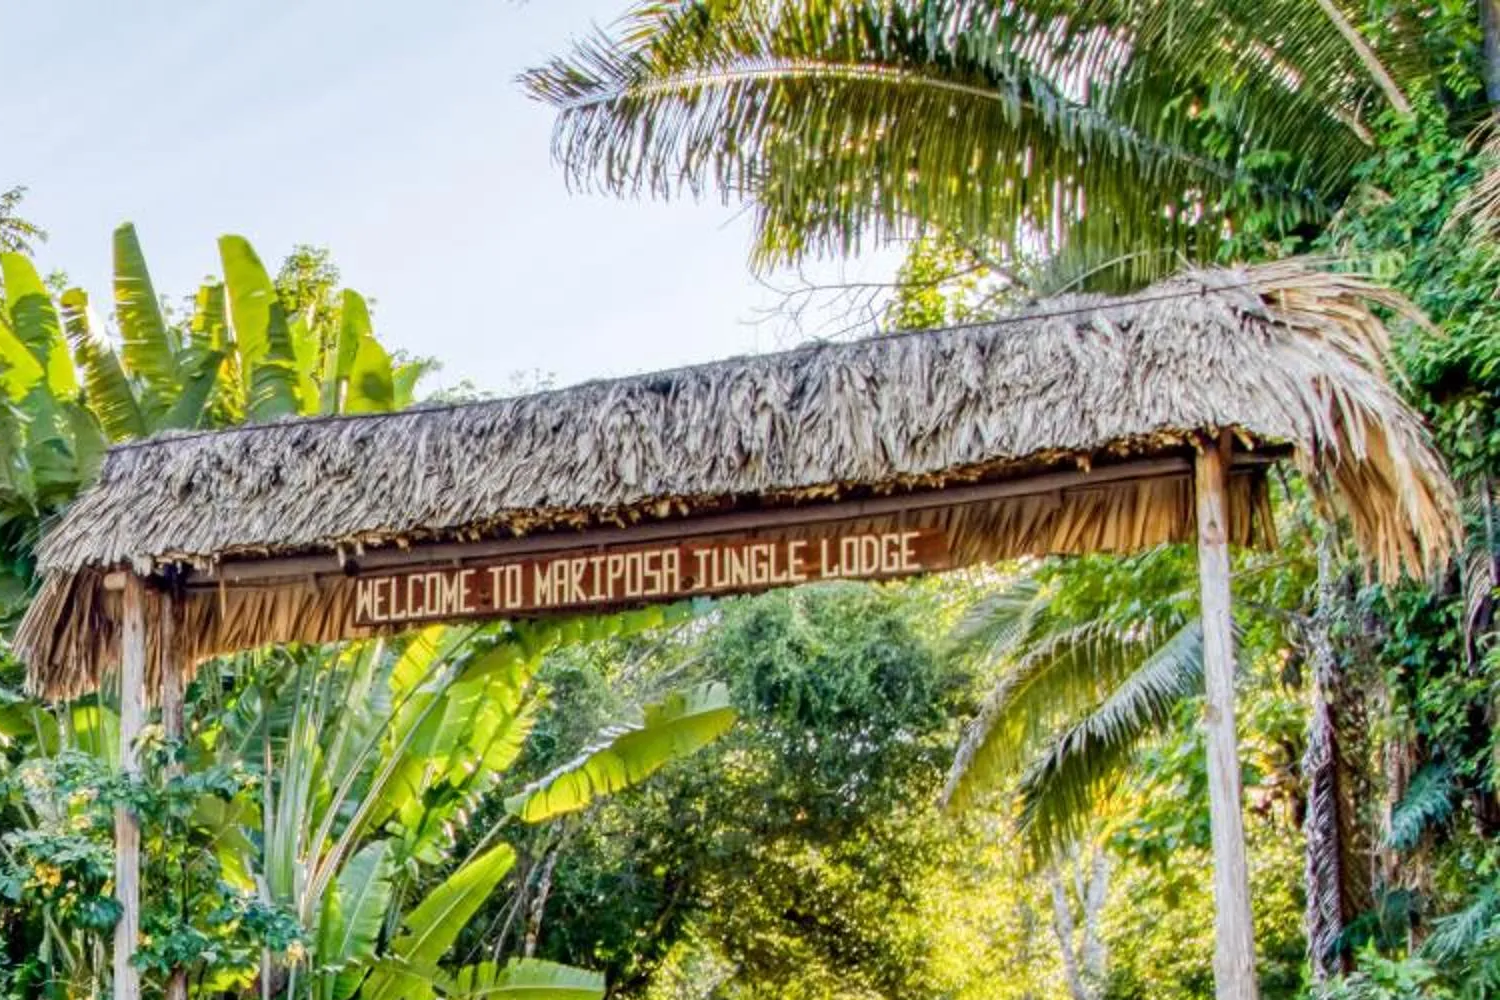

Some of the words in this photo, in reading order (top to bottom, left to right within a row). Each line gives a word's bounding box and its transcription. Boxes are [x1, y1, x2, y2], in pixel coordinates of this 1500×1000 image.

[356, 568, 476, 622] WELCOME
[487, 563, 523, 610] TO
[534, 547, 681, 607] MARIPOSA
[693, 540, 808, 589] JUNGLE
[821, 531, 921, 578] LODGE
